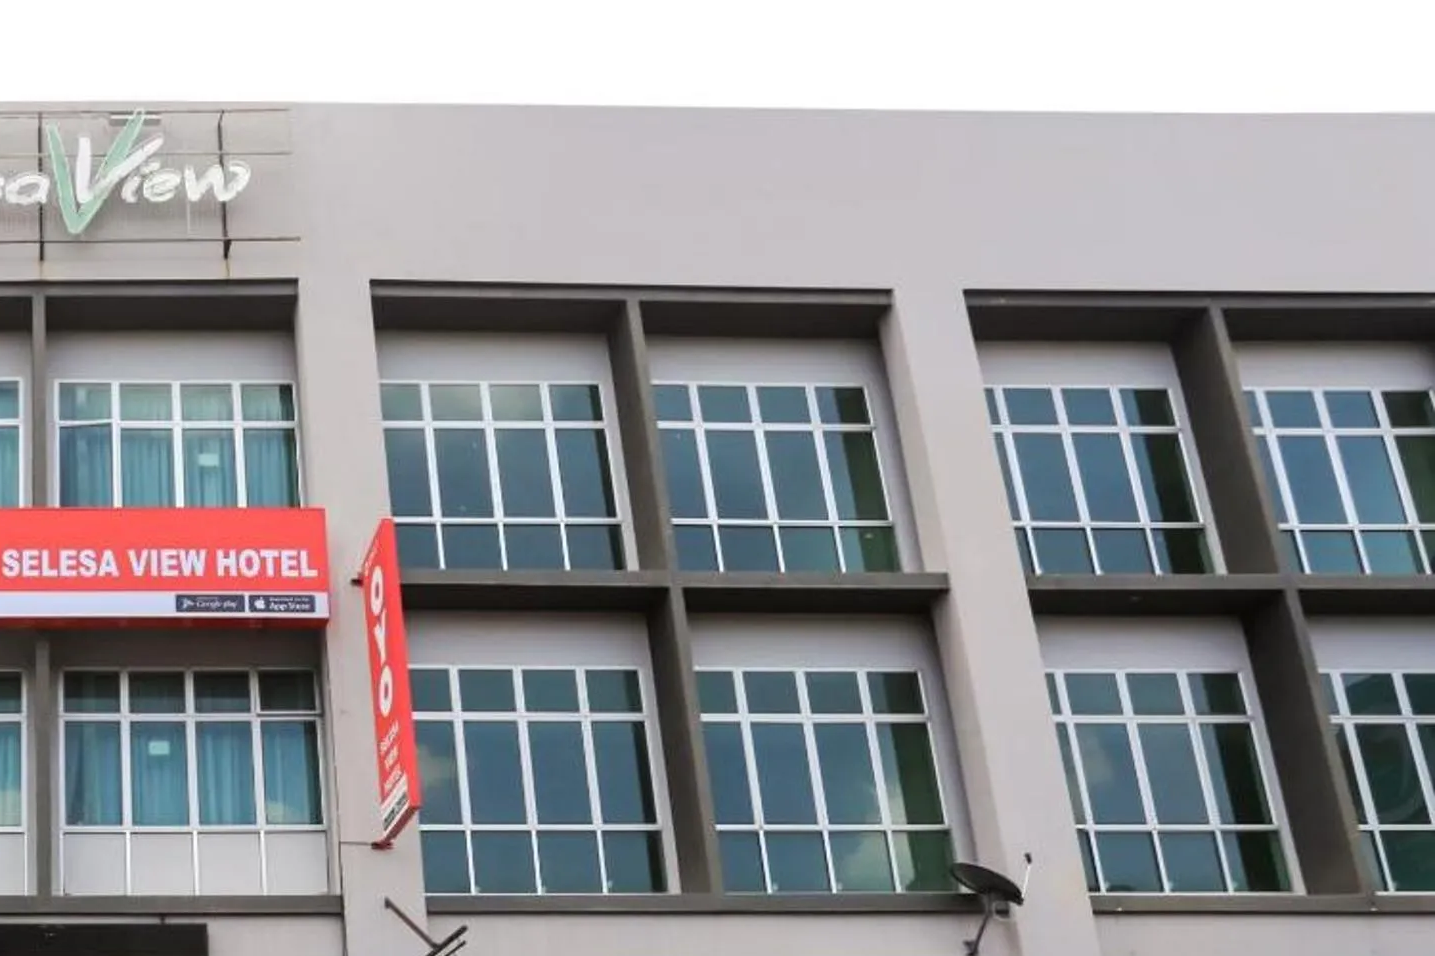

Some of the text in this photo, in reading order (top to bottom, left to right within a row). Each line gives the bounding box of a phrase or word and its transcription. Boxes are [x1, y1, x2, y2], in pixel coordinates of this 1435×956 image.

[51, 116, 252, 226] View
[2, 548, 120, 578] SELESA
[127, 548, 207, 577] VIEW
[216, 548, 319, 577] HOTEL
[370, 565, 393, 718] OYO
